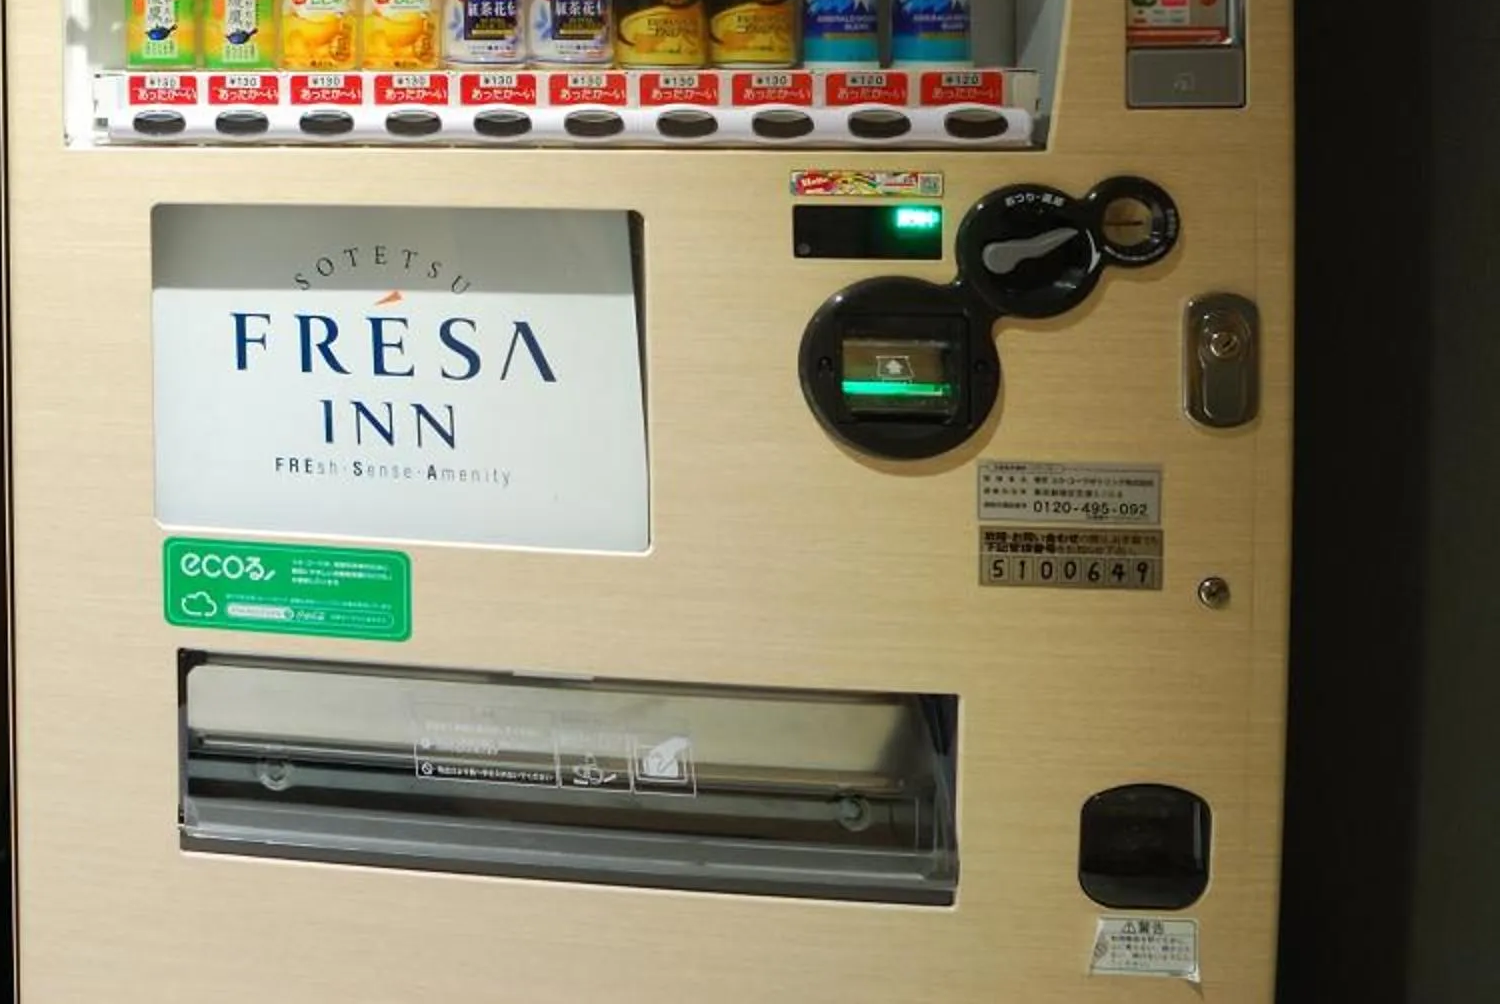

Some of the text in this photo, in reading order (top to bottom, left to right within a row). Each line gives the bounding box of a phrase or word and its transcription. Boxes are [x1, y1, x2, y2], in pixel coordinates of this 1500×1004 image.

[556, 0, 602, 17] 紅茶花
[293, 244, 472, 295] SOTETSU
[319, 398, 456, 450] INN
[1032, 499, 1149, 518] 0120-495-092
